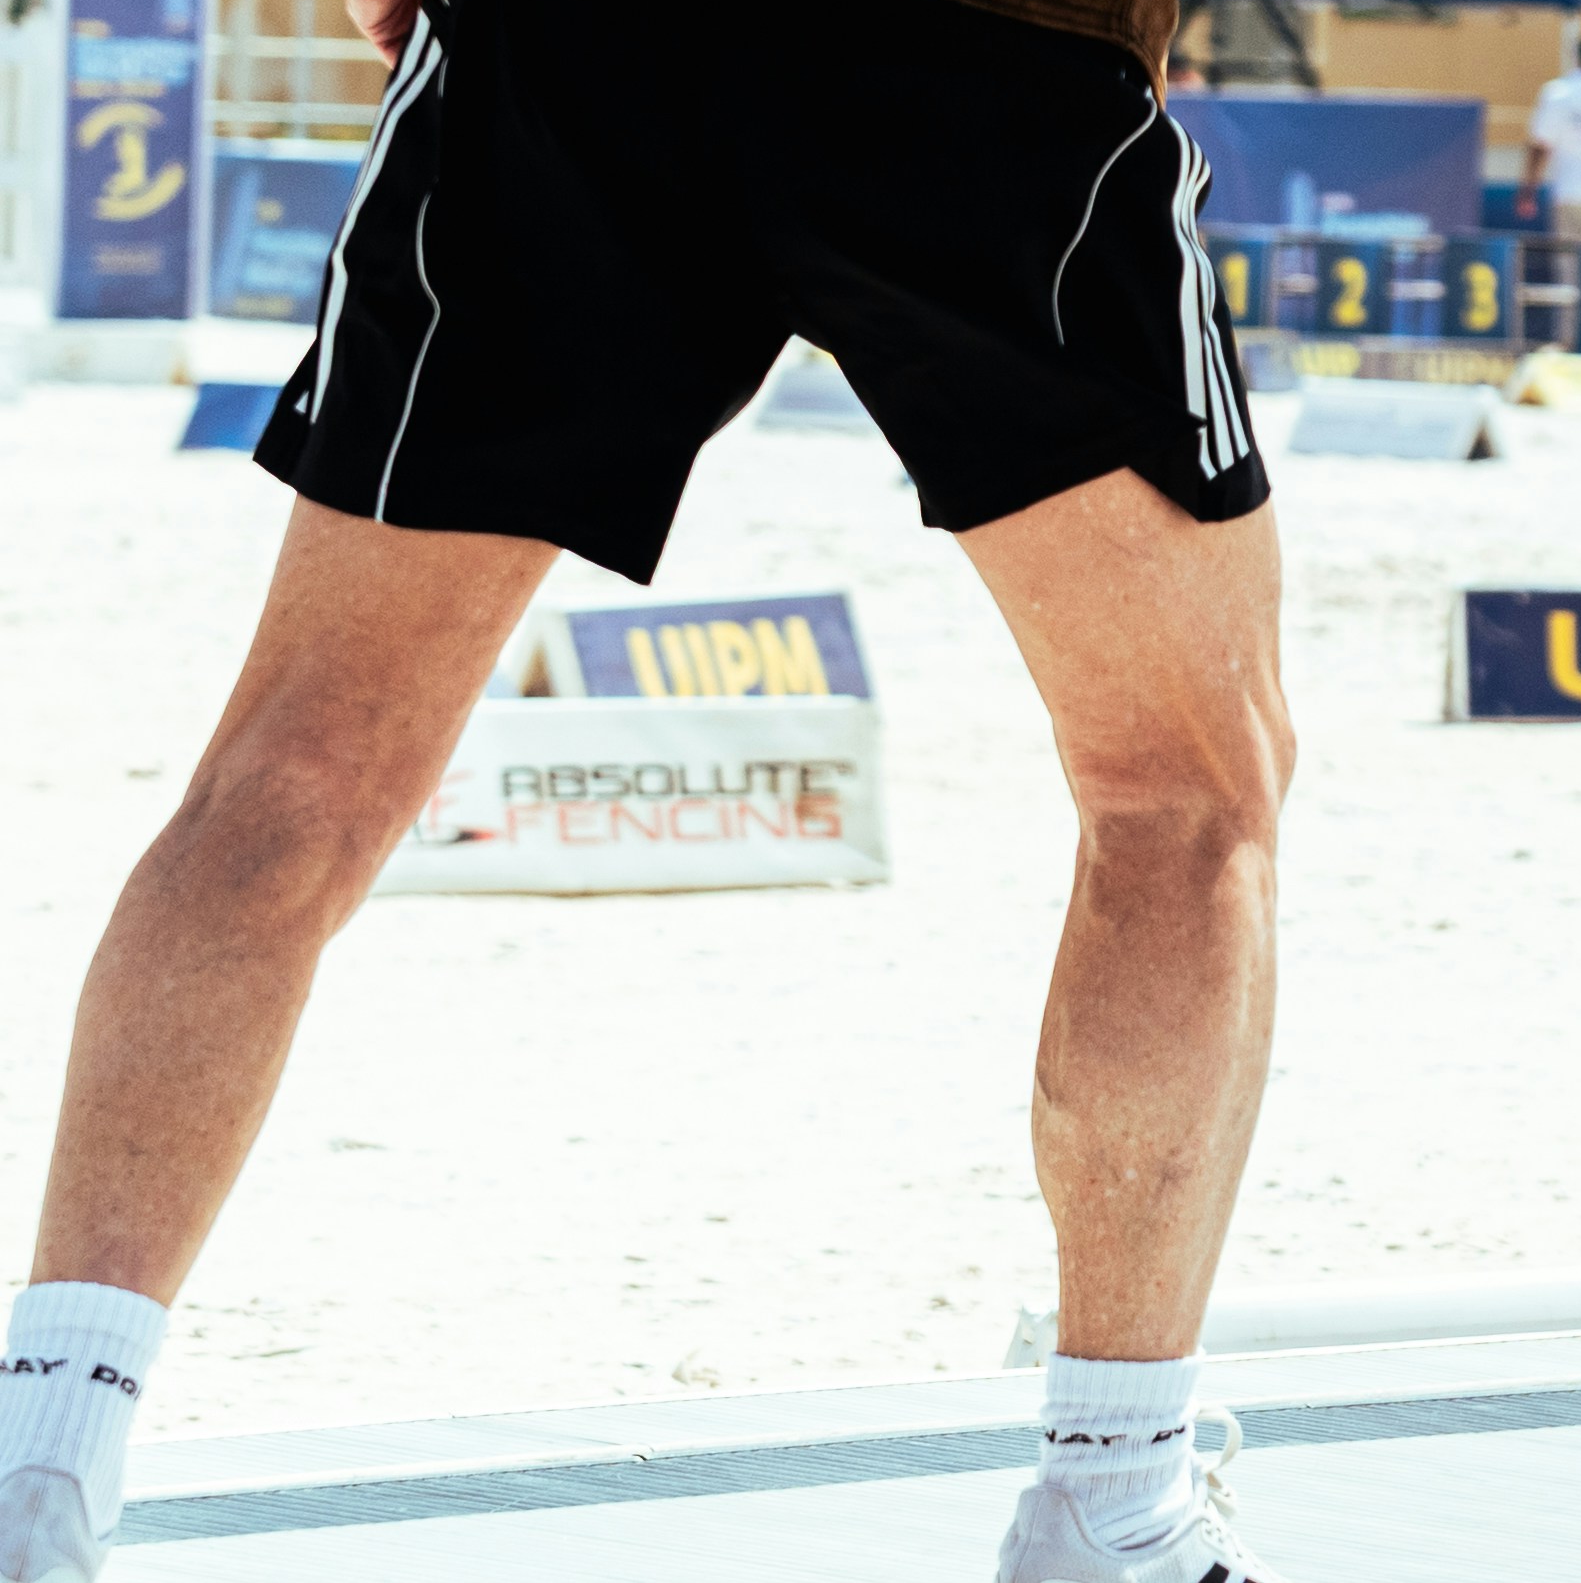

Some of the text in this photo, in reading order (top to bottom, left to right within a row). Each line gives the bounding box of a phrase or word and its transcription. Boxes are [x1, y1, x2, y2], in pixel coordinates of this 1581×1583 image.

[1222, 254, 1249, 317] 1
[1333, 258, 1367, 326] 2
[1464, 262, 1499, 331] 3
[626, 615, 830, 699] UIPM
[504, 797, 843, 845] FENCING
